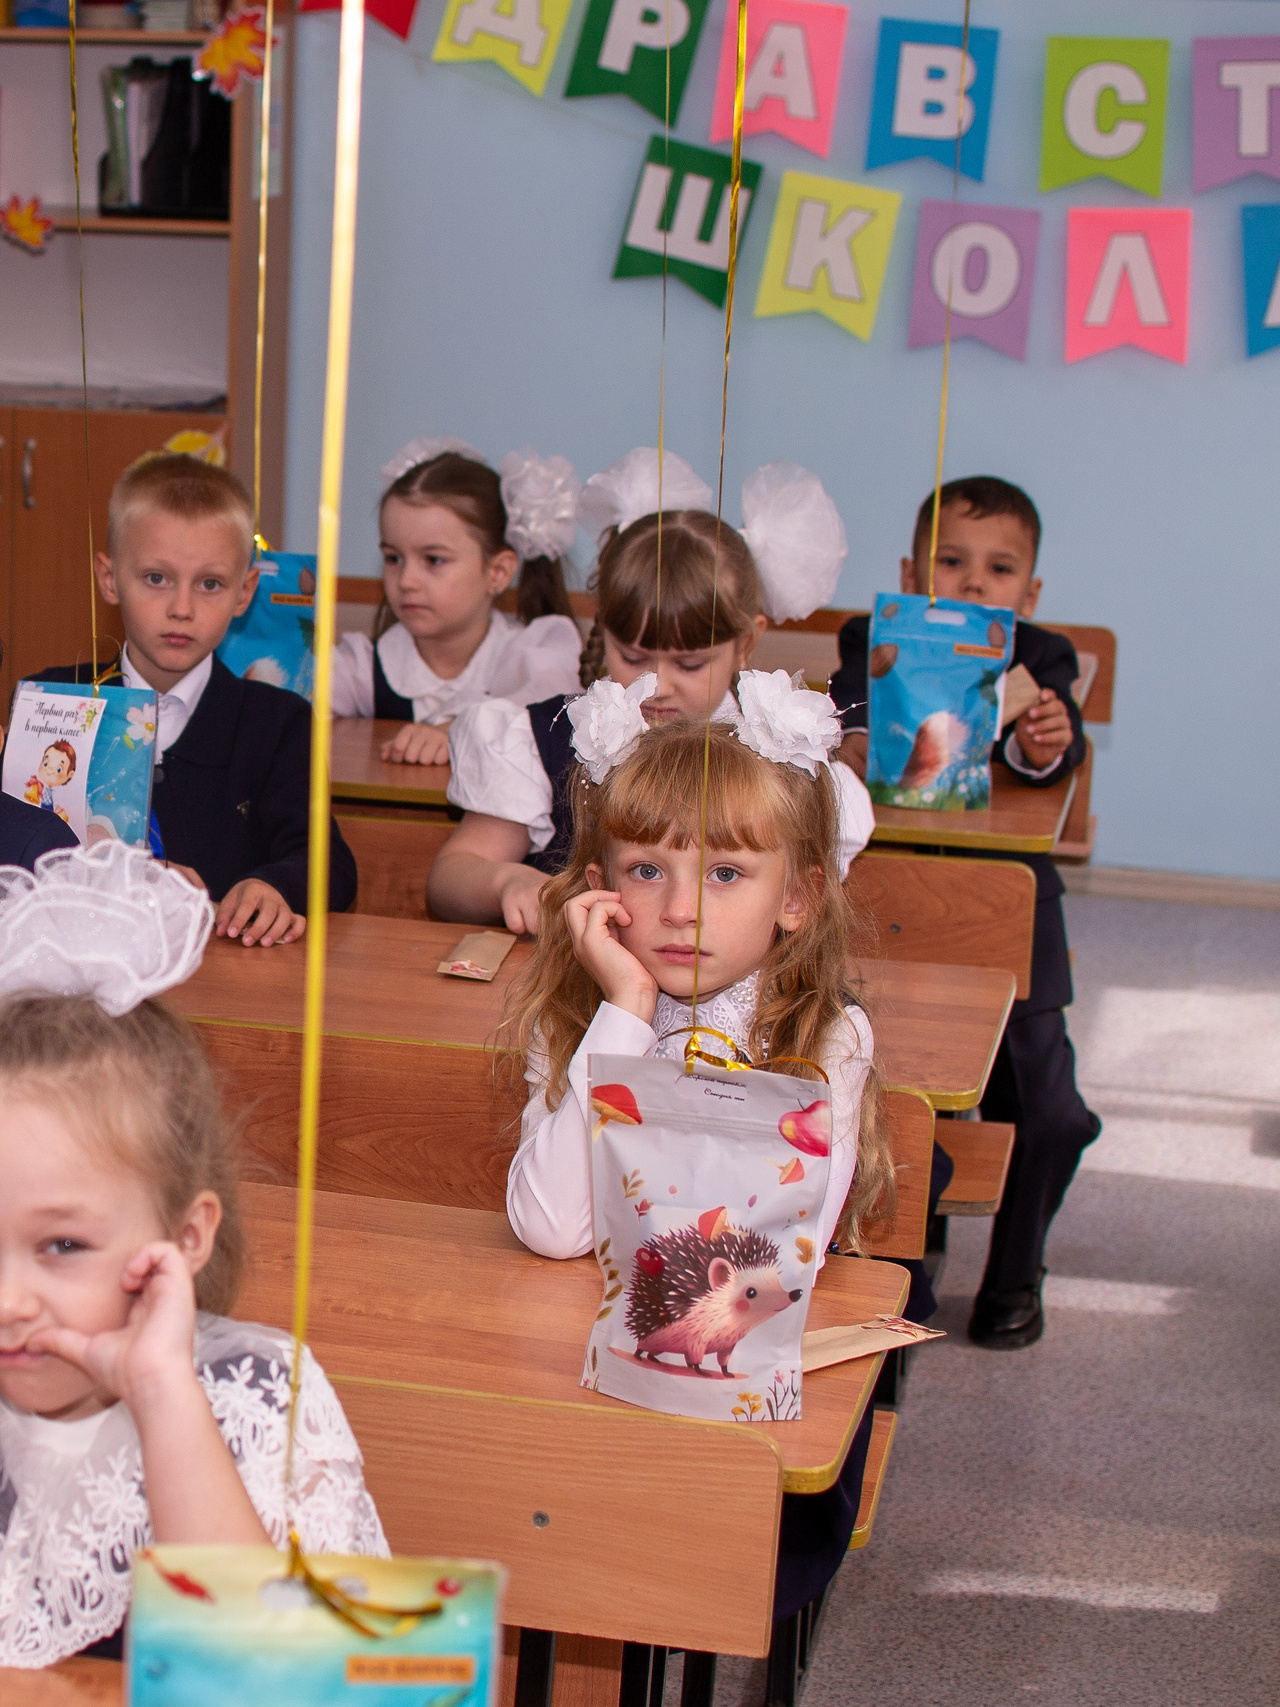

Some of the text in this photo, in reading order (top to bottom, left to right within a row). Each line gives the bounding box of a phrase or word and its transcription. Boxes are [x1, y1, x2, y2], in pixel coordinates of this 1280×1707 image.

[625, 162, 1280, 328] ШКОЛ
[35, 701, 80, 724] Первый раз
[24, 718, 80, 738] в первый класс
